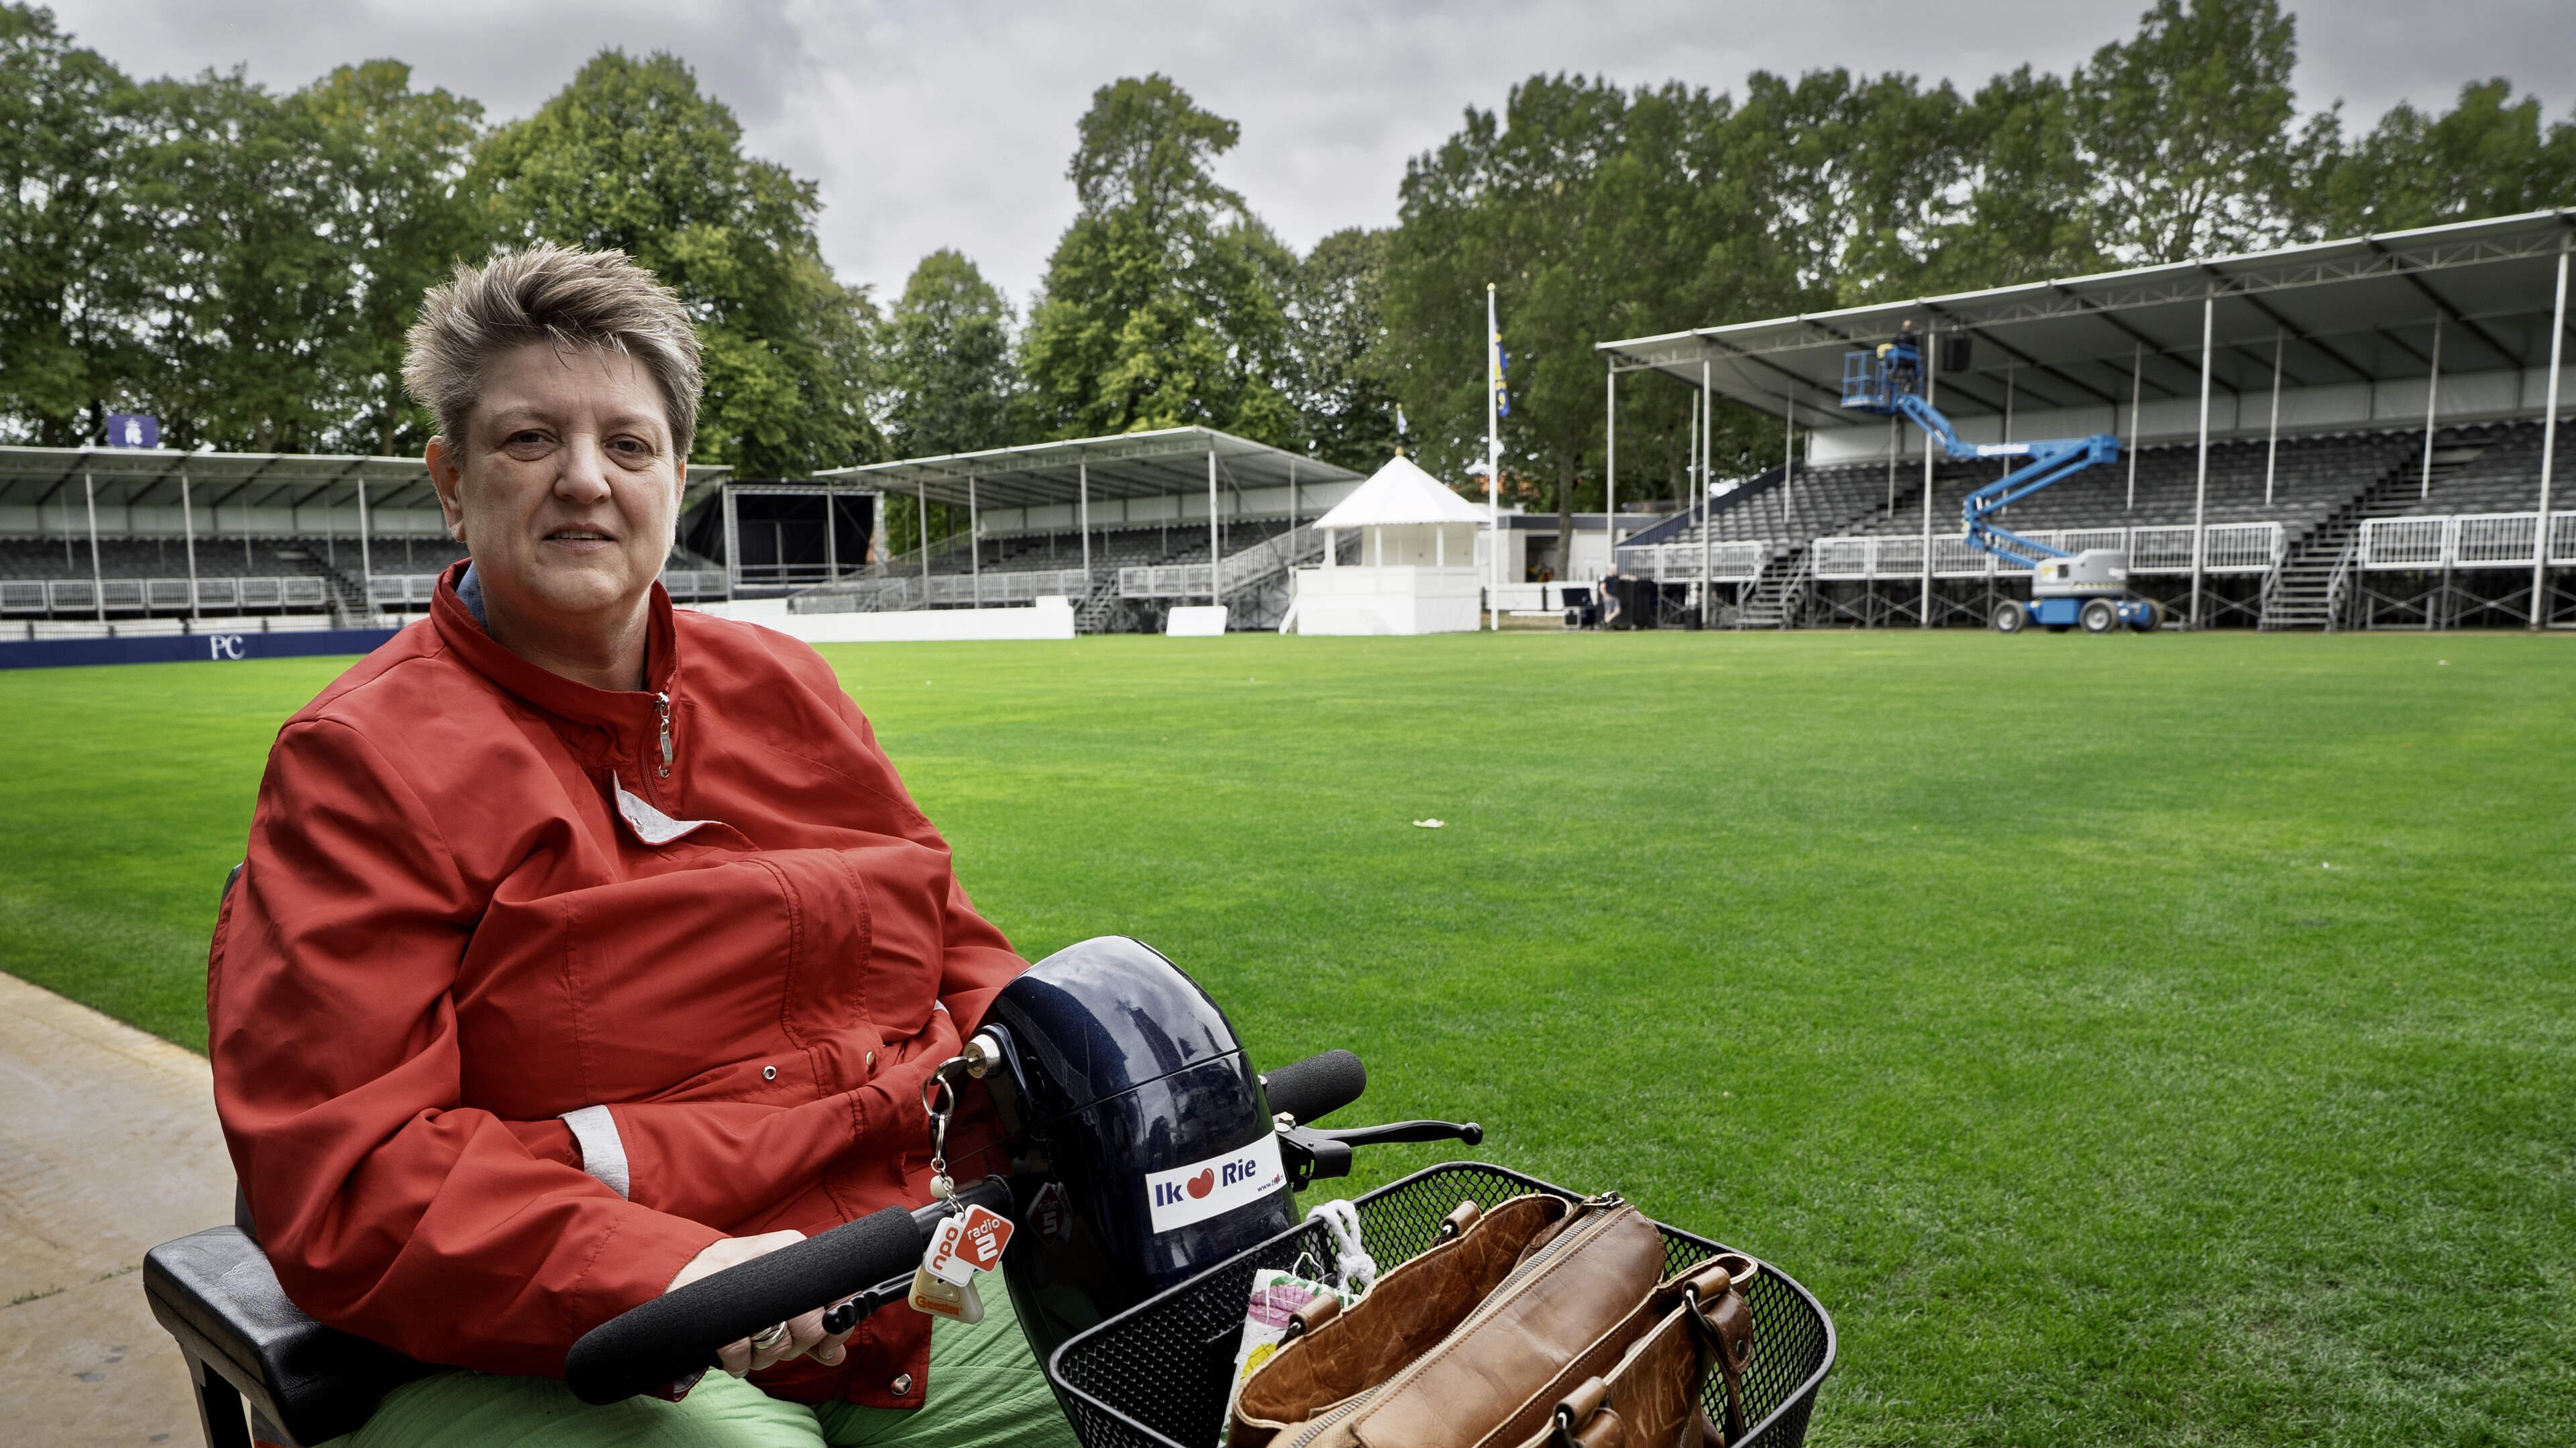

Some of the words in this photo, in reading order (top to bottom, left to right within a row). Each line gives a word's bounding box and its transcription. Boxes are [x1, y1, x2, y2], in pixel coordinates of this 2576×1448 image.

[210, 634, 246, 660] PC
[1155, 1182, 1183, 1207] Ik
[1222, 1158, 1256, 1187] Rie
[967, 1218, 1000, 1241] radio
[932, 1227, 958, 1270] npo
[975, 1232, 999, 1262] 2
